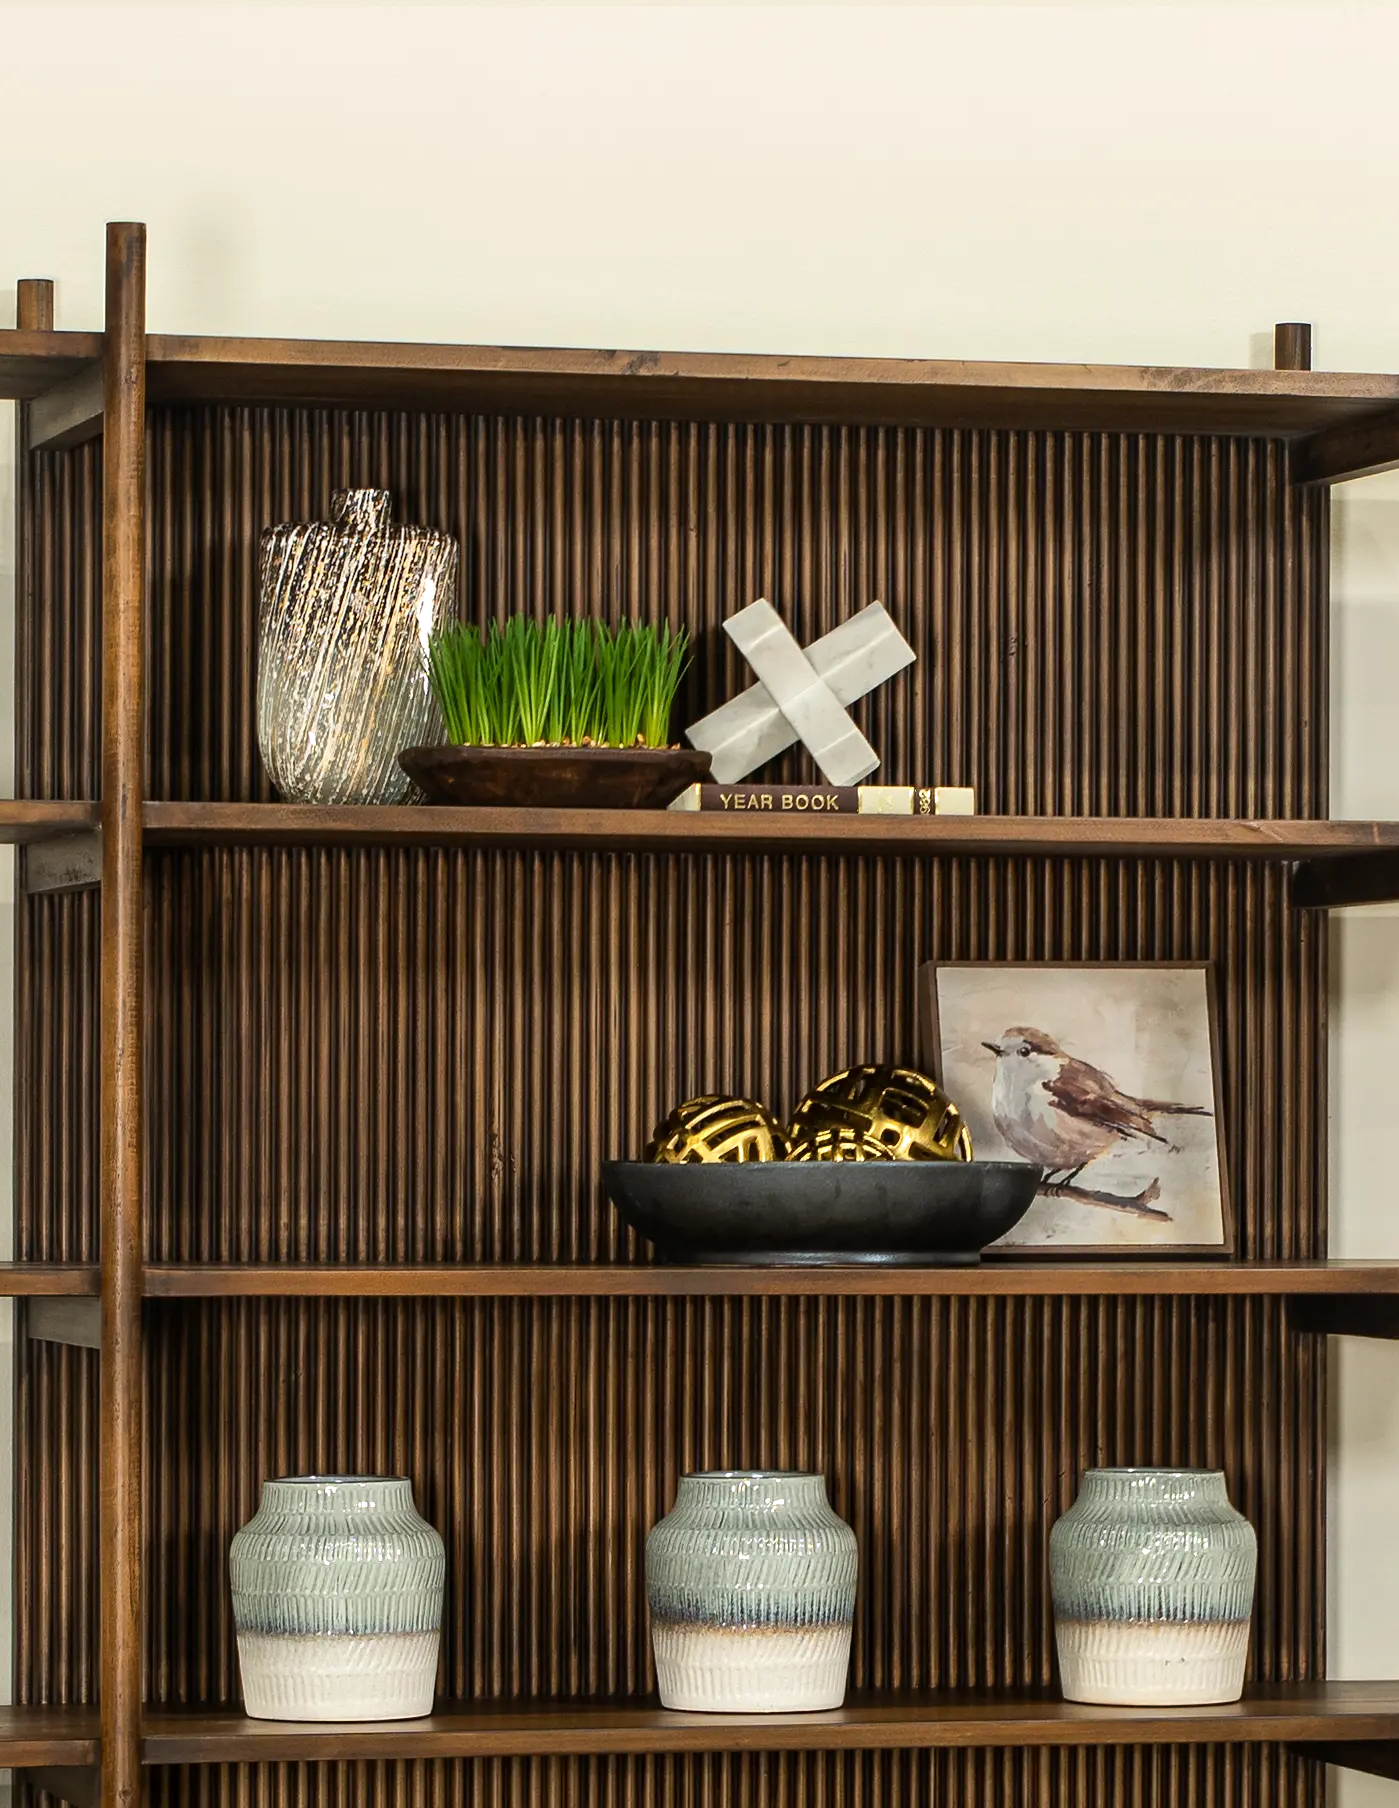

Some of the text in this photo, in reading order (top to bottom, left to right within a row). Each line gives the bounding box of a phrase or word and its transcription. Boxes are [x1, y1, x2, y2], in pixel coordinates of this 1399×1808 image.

[719, 794, 840, 811] YEAR BOOK
[918, 789, 931, 814] 982
